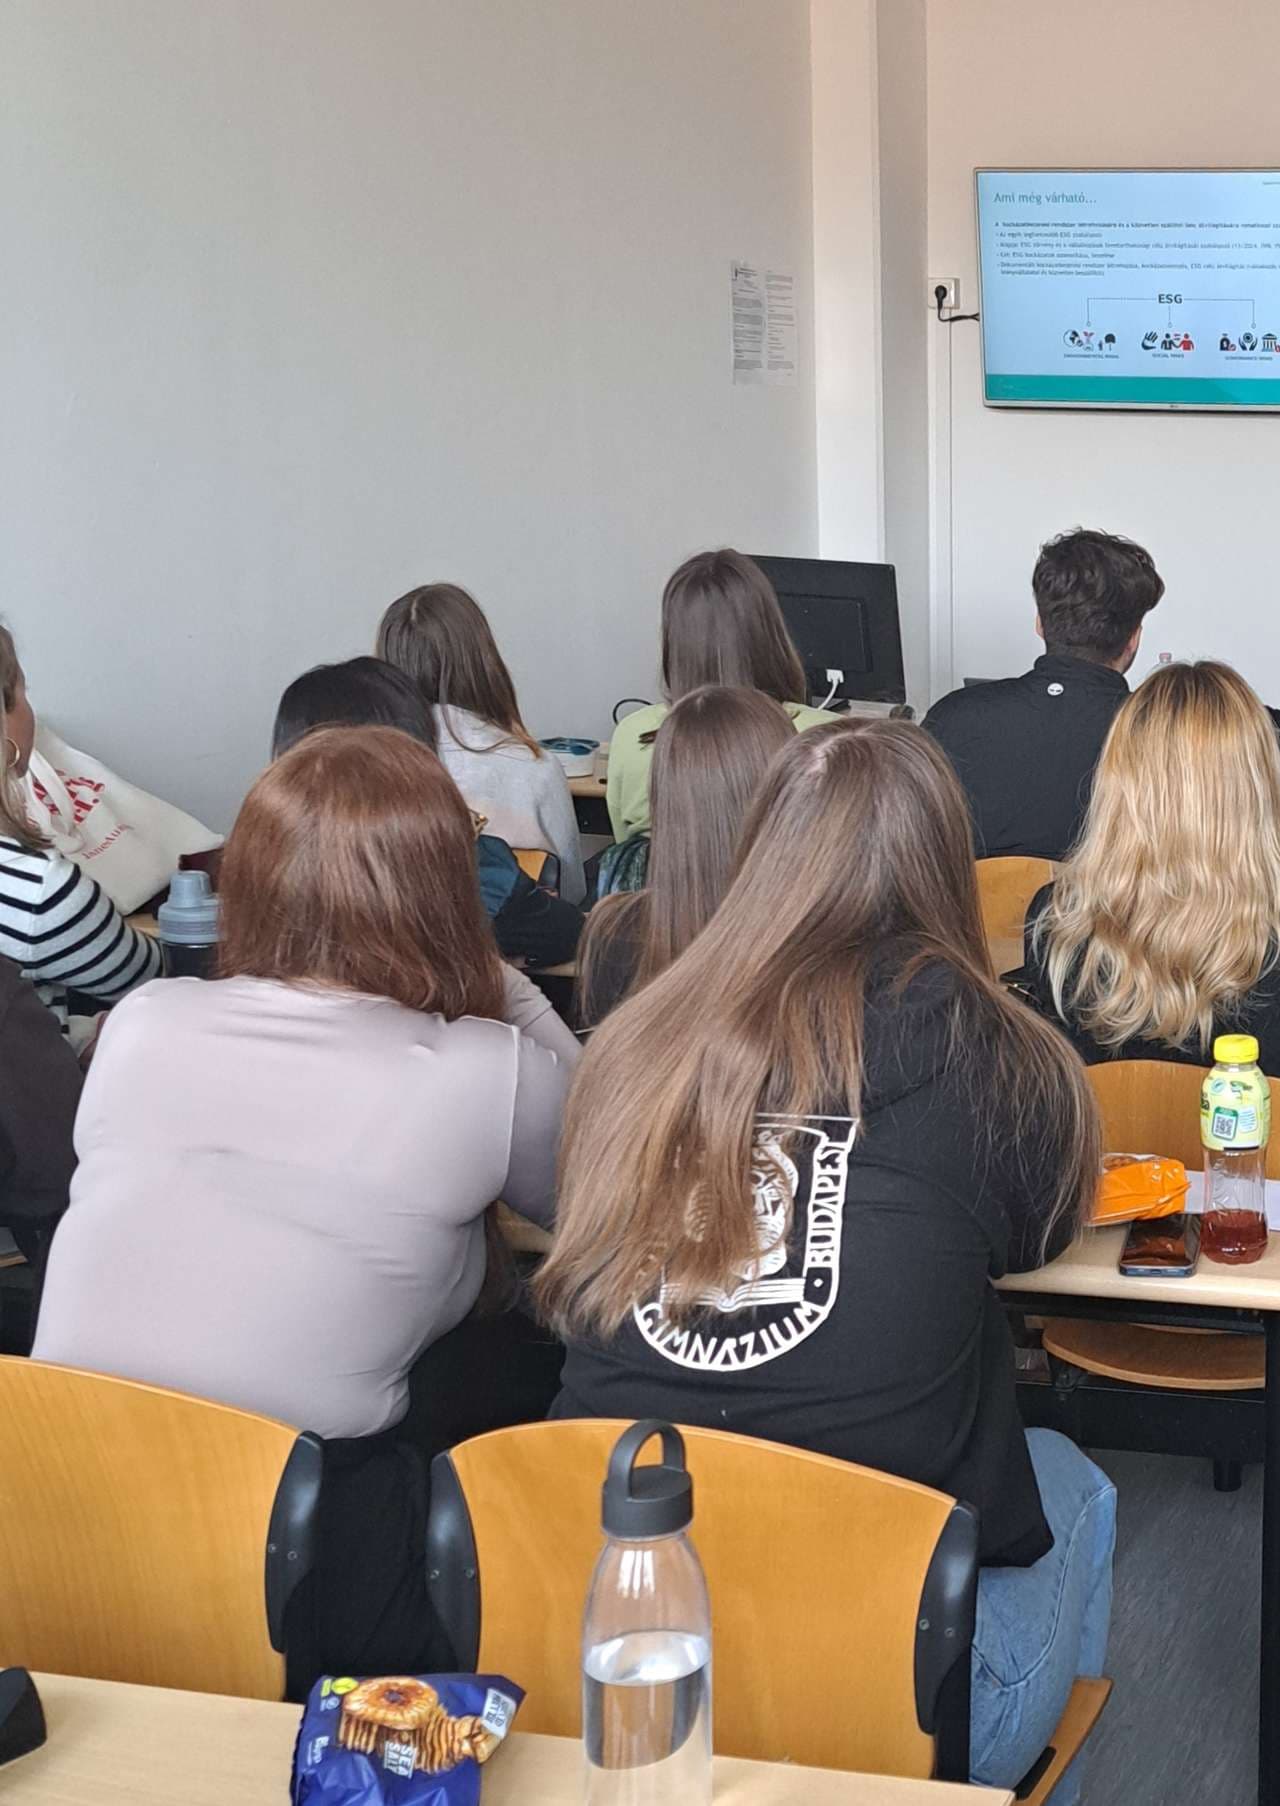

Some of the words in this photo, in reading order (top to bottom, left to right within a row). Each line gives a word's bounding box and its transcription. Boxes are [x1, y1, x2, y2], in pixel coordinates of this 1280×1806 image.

[993, 191, 1015, 204] Ami
[1018, 191, 1042, 206] még
[1157, 293, 1183, 305] ESG
